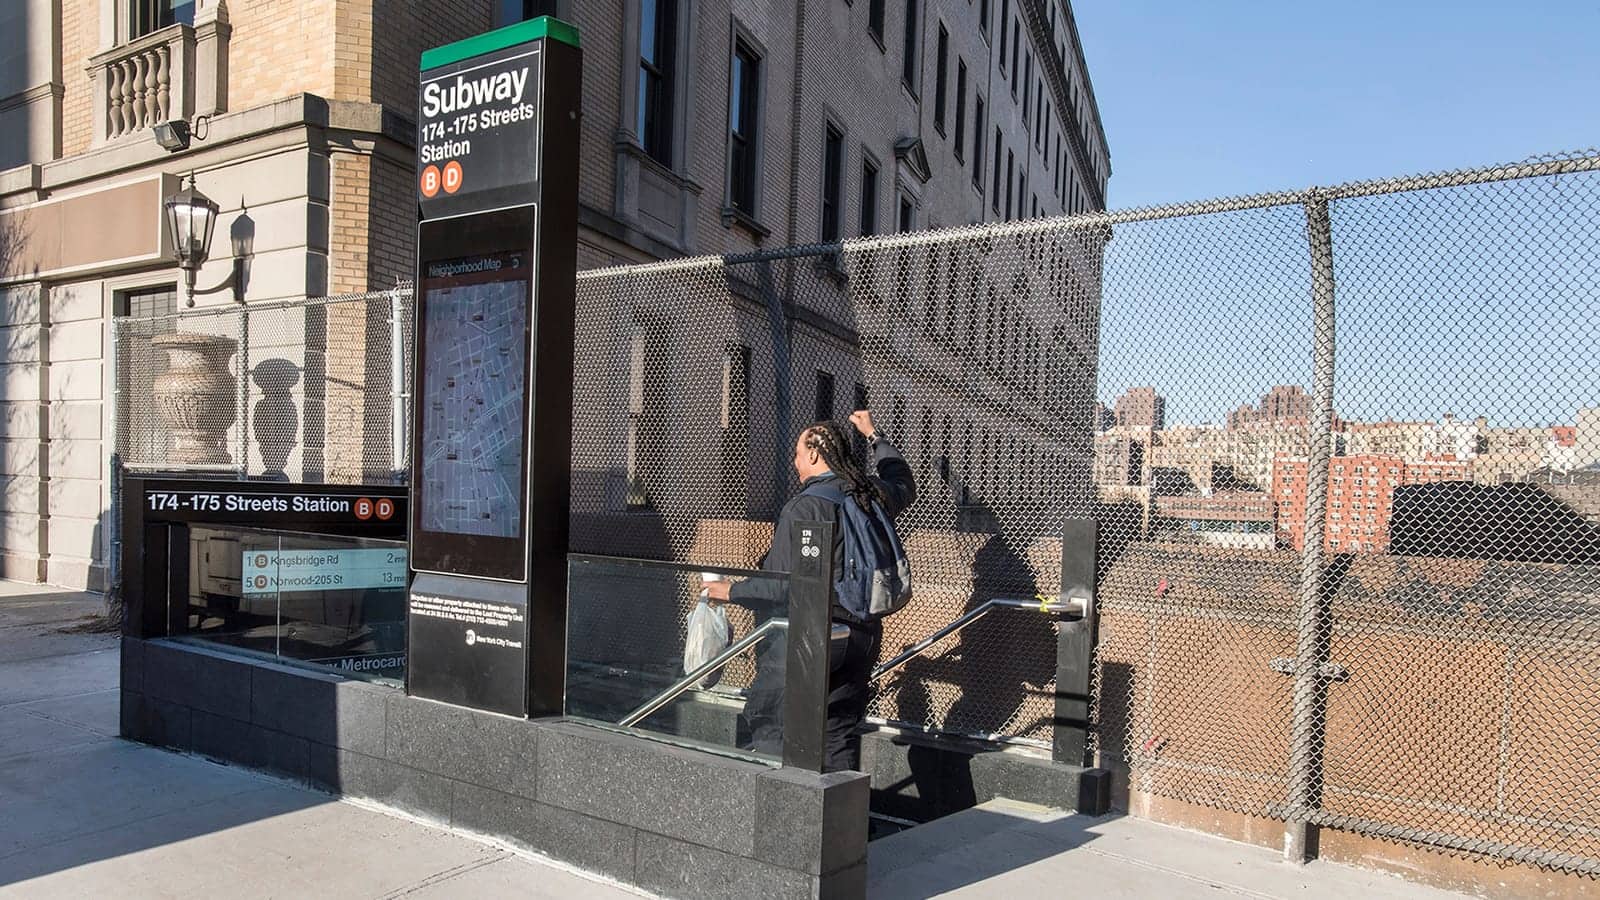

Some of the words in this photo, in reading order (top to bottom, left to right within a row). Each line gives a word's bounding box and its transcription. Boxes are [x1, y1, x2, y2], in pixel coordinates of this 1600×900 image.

[423, 67, 529, 118] Subway
[480, 102, 534, 129] Streets
[421, 140, 470, 163] Station
[425, 172, 437, 190] B
[447, 168, 459, 187] D
[429, 260, 483, 277] Neighborhood
[484, 259, 501, 271] Map
[225, 495, 288, 512] Streets
[292, 496, 349, 512] Station
[359, 503, 369, 516] B
[380, 503, 390, 516] D
[271, 555, 325, 567] Kngsbridge
[327, 554, 339, 565] Rd
[386, 552, 393, 564] 2
[333, 574, 343, 585] St
[382, 572, 392, 583] 13
[476, 635, 486, 643] New
[486, 636, 496, 644] York
[497, 638, 506, 647] City
[506, 639, 522, 649] Transit
